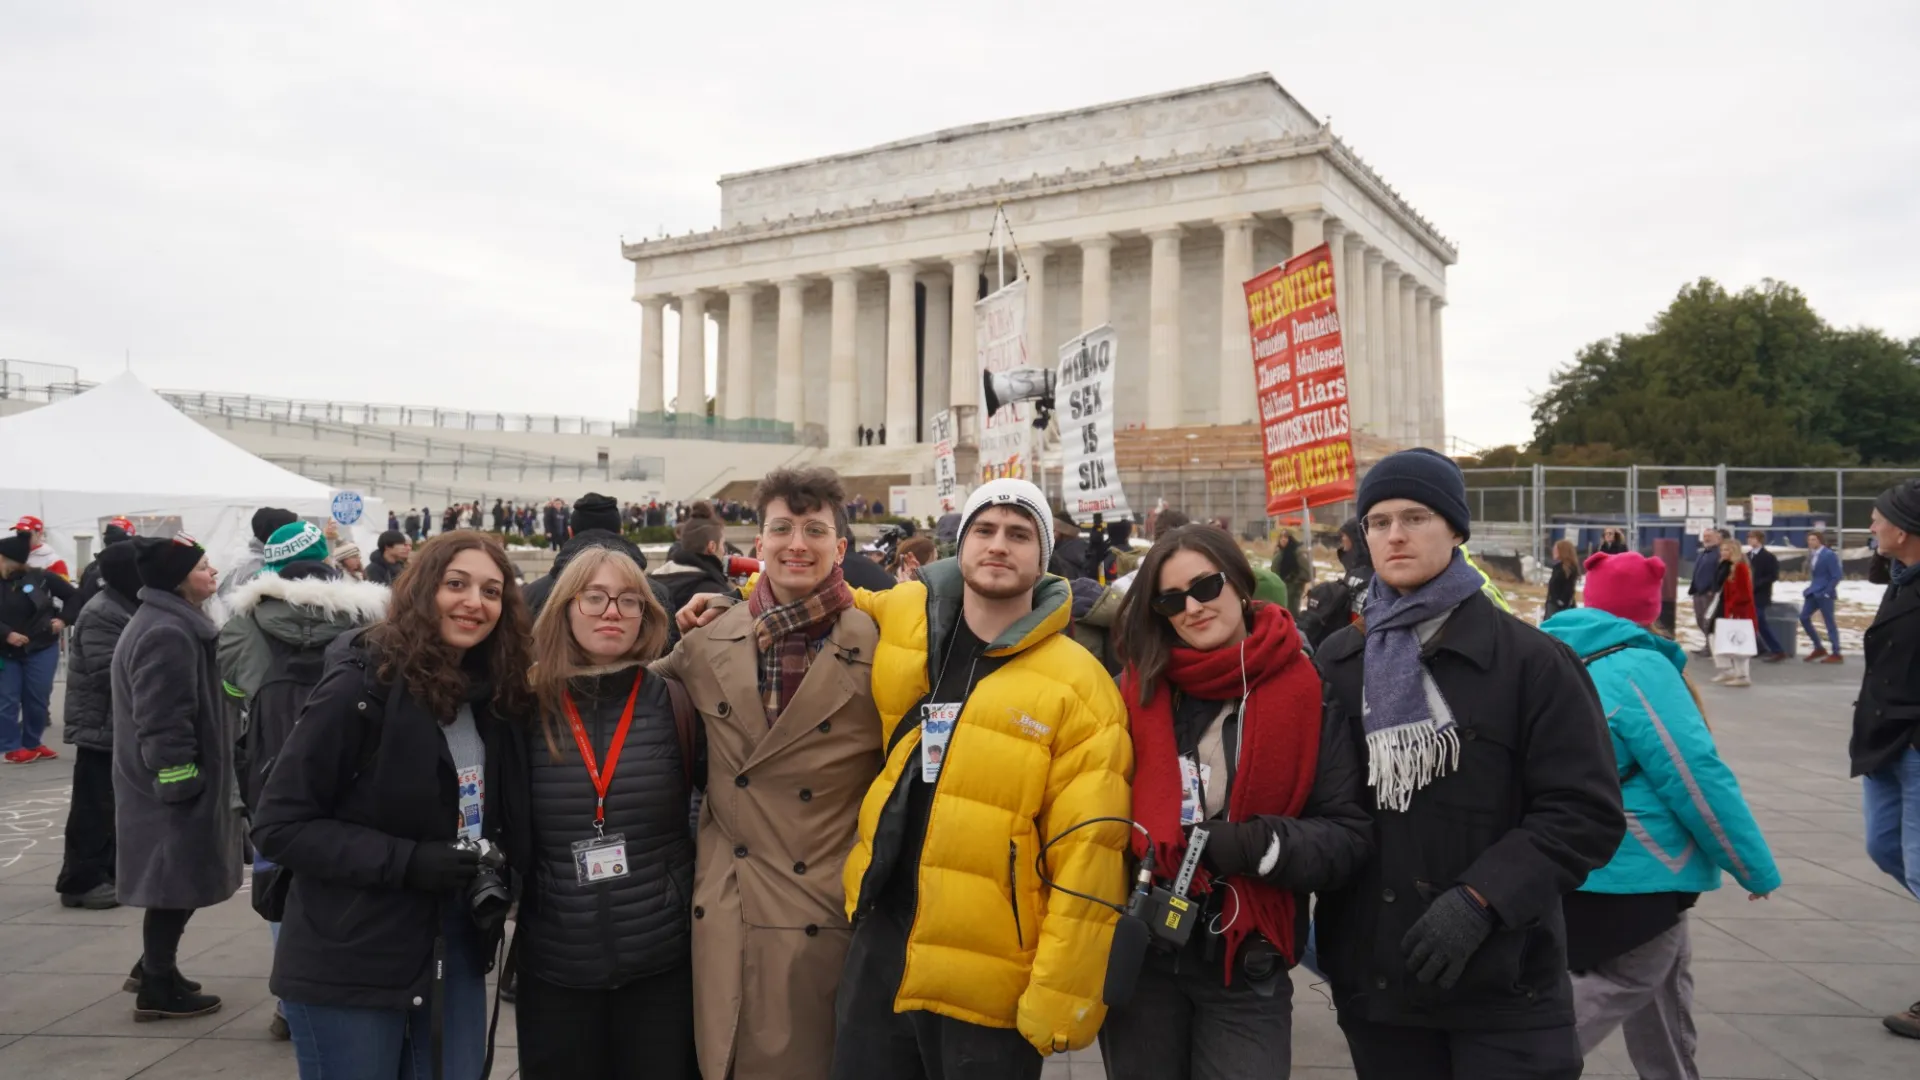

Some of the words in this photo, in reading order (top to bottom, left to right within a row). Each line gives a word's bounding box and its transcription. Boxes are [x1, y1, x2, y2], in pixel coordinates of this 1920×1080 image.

[1249, 261, 1332, 328] WARNING
[1291, 308, 1340, 345] Drunkards
[1061, 339, 1110, 388] HOMO
[1258, 362, 1291, 390] Thieves
[1295, 346, 1345, 377] Adulterers
[1069, 381, 1103, 420] SEX
[1297, 377, 1347, 409] Liars
[1081, 421, 1099, 455] IS
[1265, 403, 1349, 455] HOMOSEXUALS
[1078, 458, 1109, 491] SIN
[1269, 441, 1351, 498] JUDGMENT
[458, 773, 477, 784] ESS
